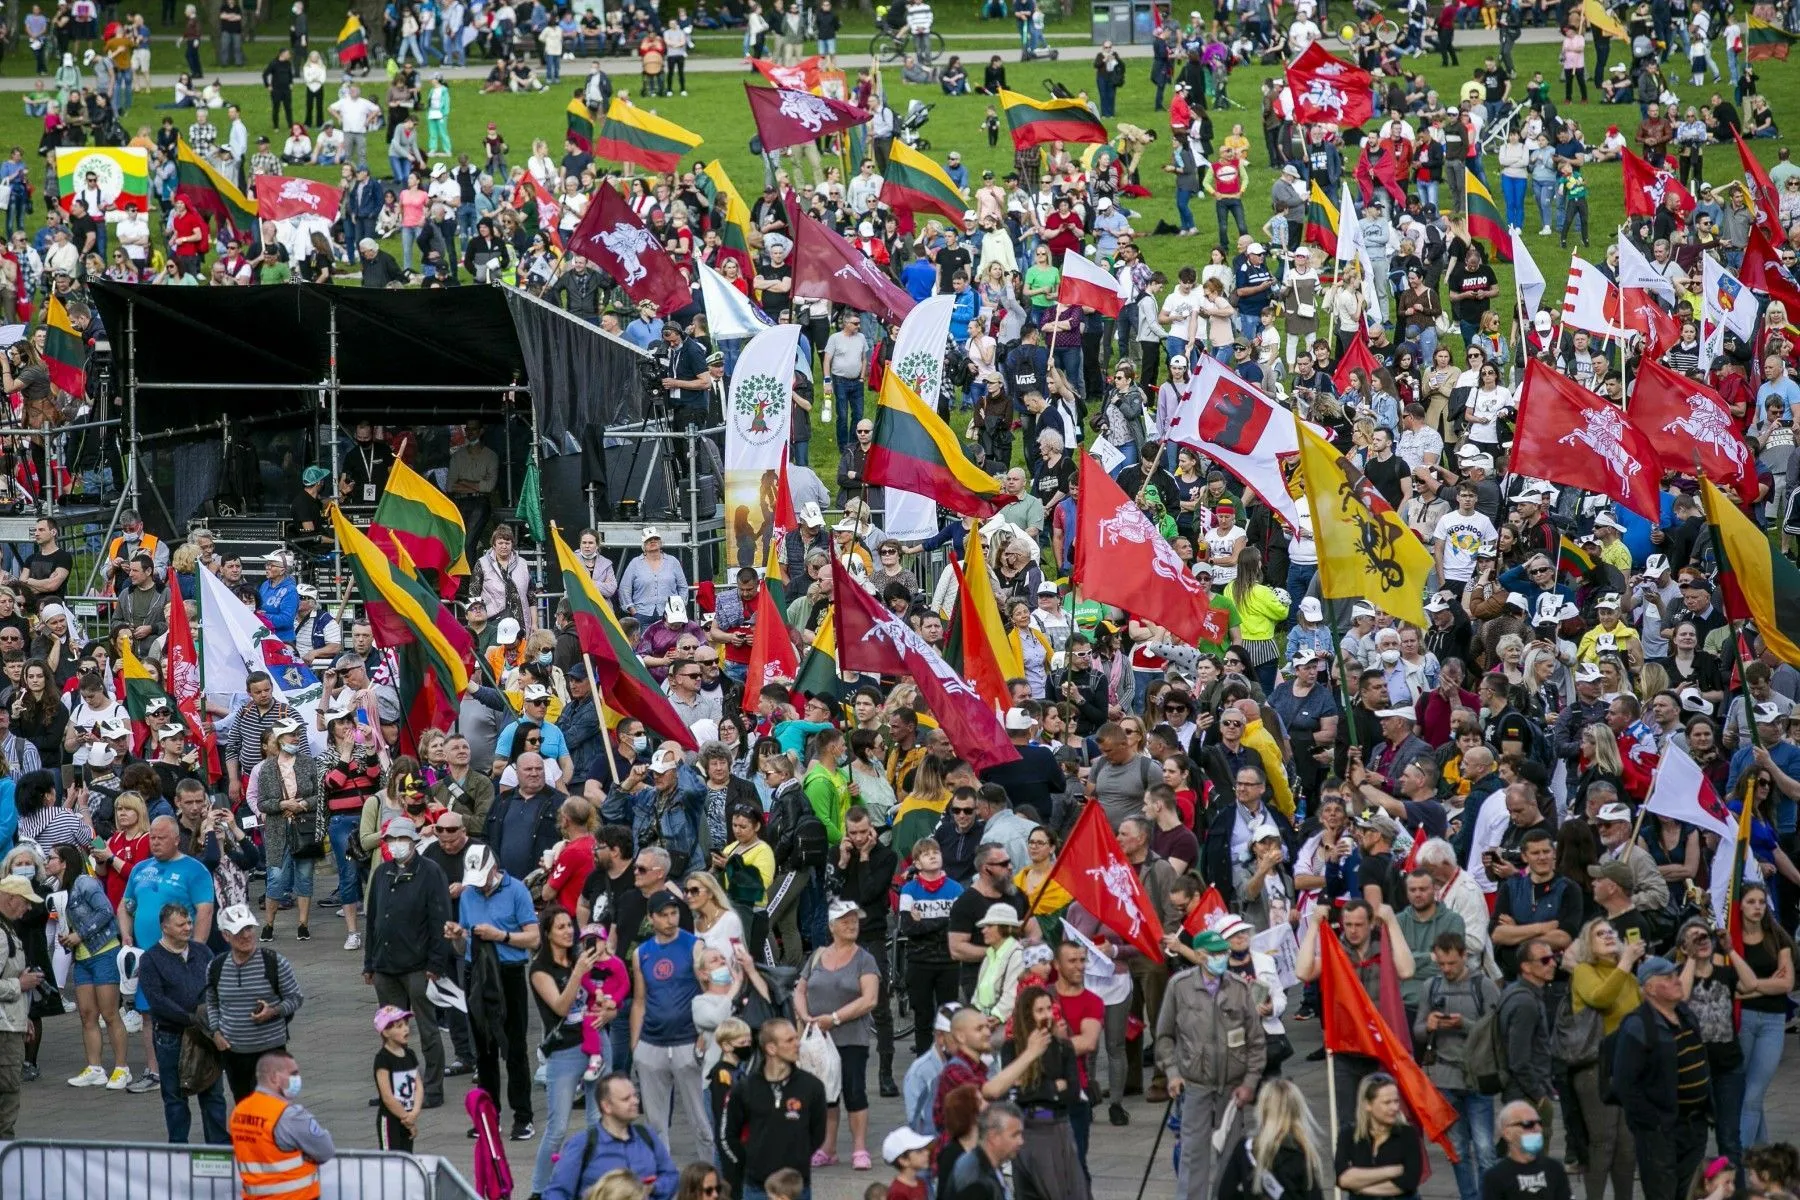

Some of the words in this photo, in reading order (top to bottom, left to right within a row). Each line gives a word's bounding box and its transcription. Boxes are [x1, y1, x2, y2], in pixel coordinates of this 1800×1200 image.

[1462, 278, 1477, 287] JUST
[1477, 276, 1488, 285] DO
[1016, 372, 1036, 384] VANS
[914, 900, 952, 912] FAMOUS
